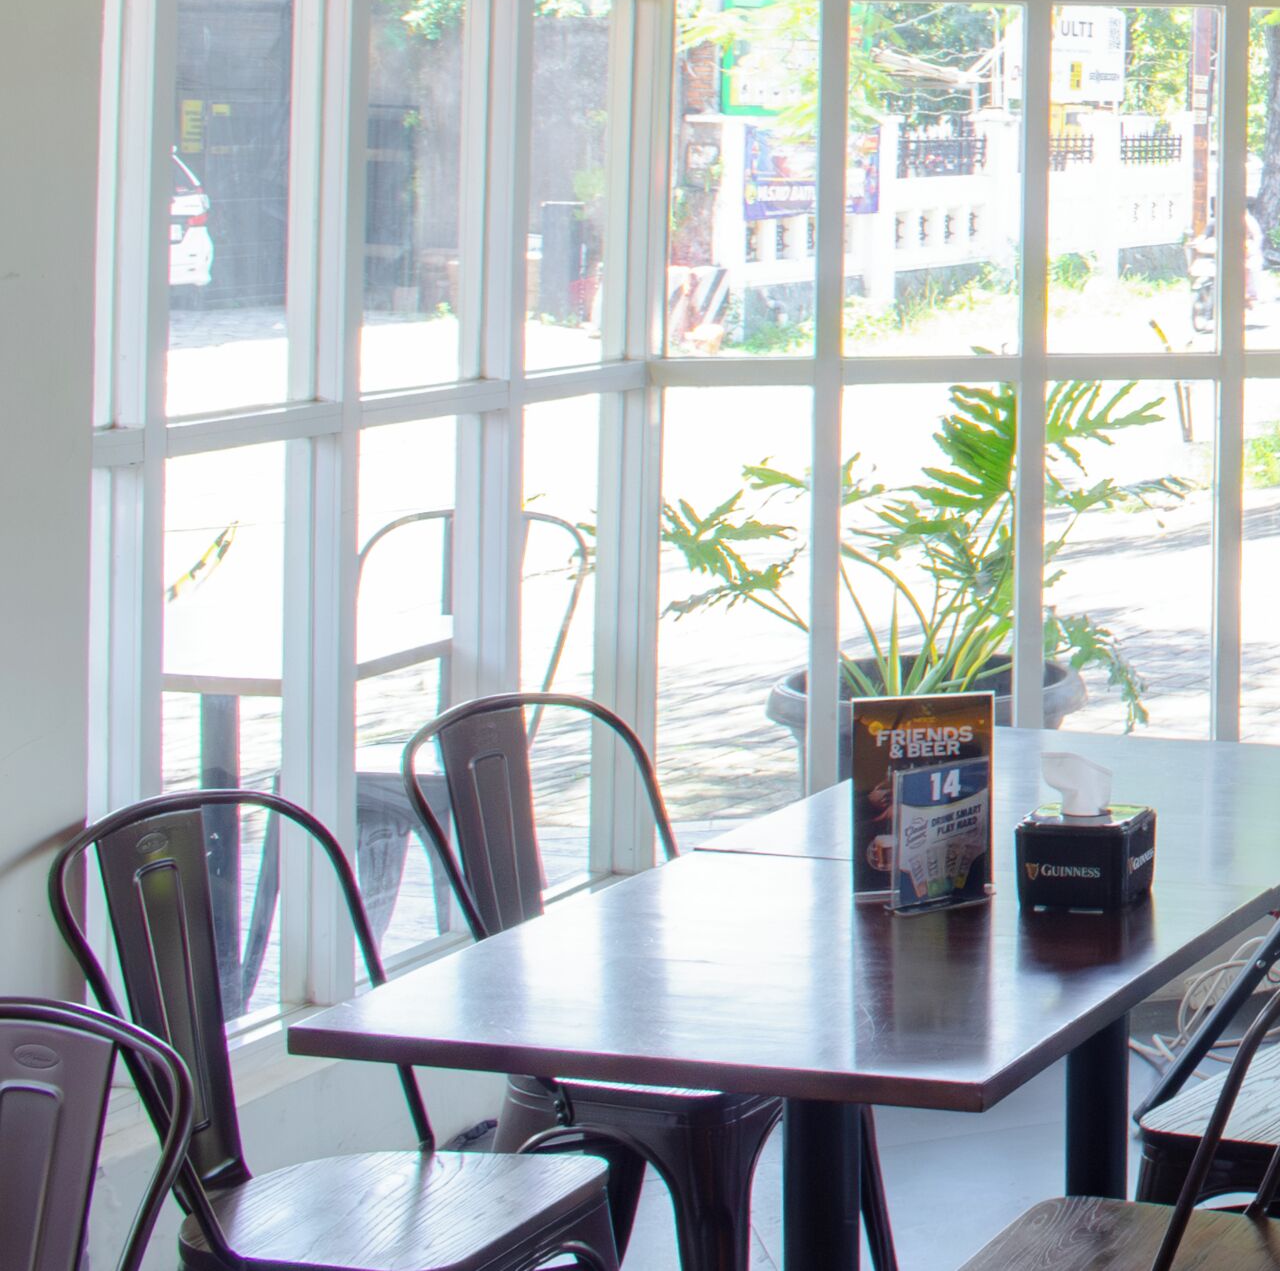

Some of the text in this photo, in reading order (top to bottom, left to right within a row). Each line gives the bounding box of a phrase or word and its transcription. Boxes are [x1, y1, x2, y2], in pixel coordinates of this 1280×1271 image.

[876, 725, 973, 747] FRIENDS
[889, 740, 960, 759] & BEER
[930, 769, 961, 800] 14
[1041, 864, 1100, 878] GUINNESS
